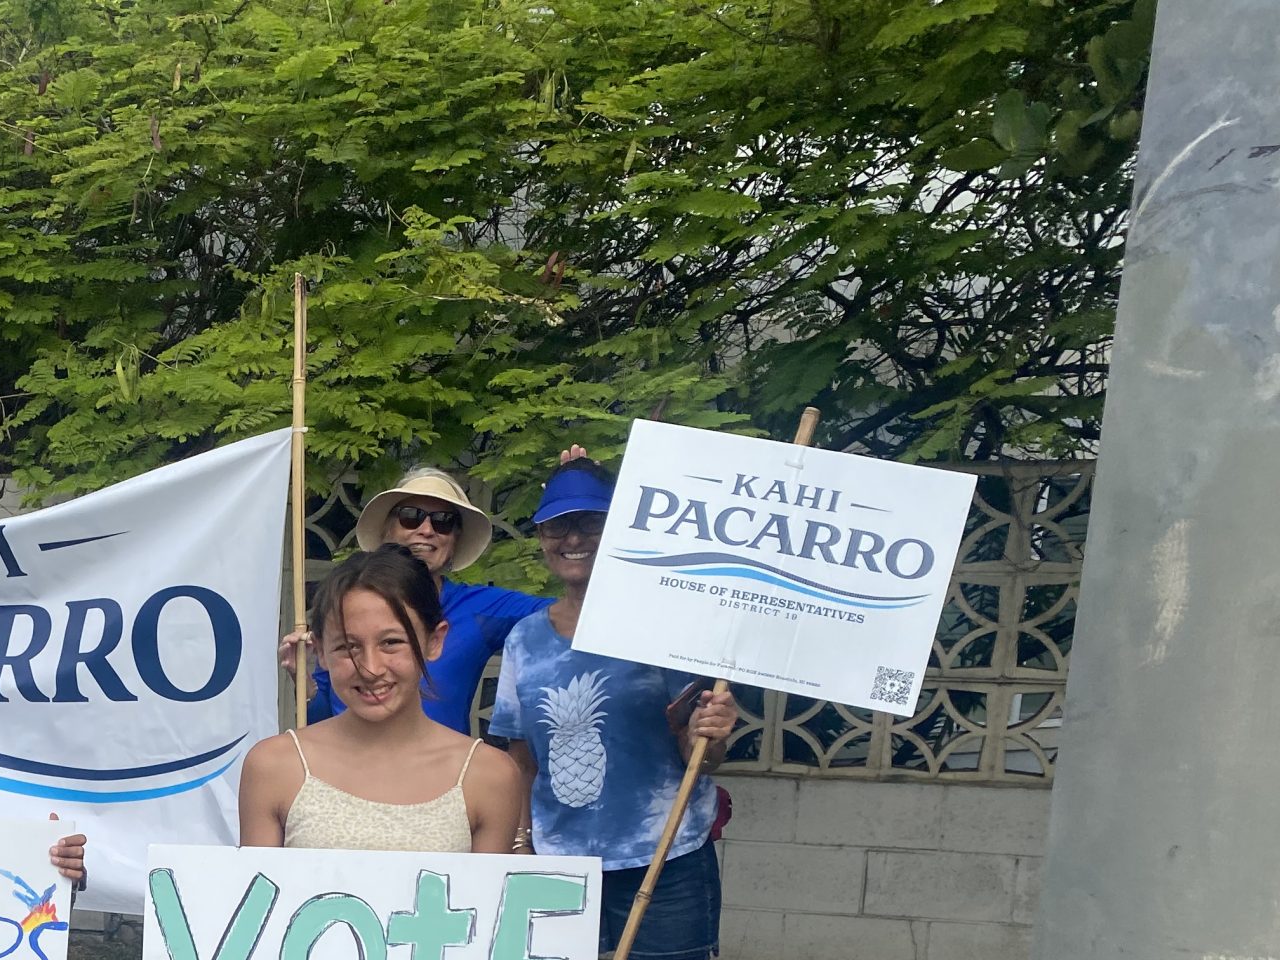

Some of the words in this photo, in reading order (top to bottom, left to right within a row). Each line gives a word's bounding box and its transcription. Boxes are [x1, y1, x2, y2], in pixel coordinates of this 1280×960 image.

[731, 473, 843, 512] KAHI
[628, 485, 935, 580] PACARRO
[659, 576, 707, 593] HOUSE
[709, 585, 728, 596] OF
[731, 589, 865, 624] REPRESENTATIVES
[719, 598, 781, 617] DISTRICT
